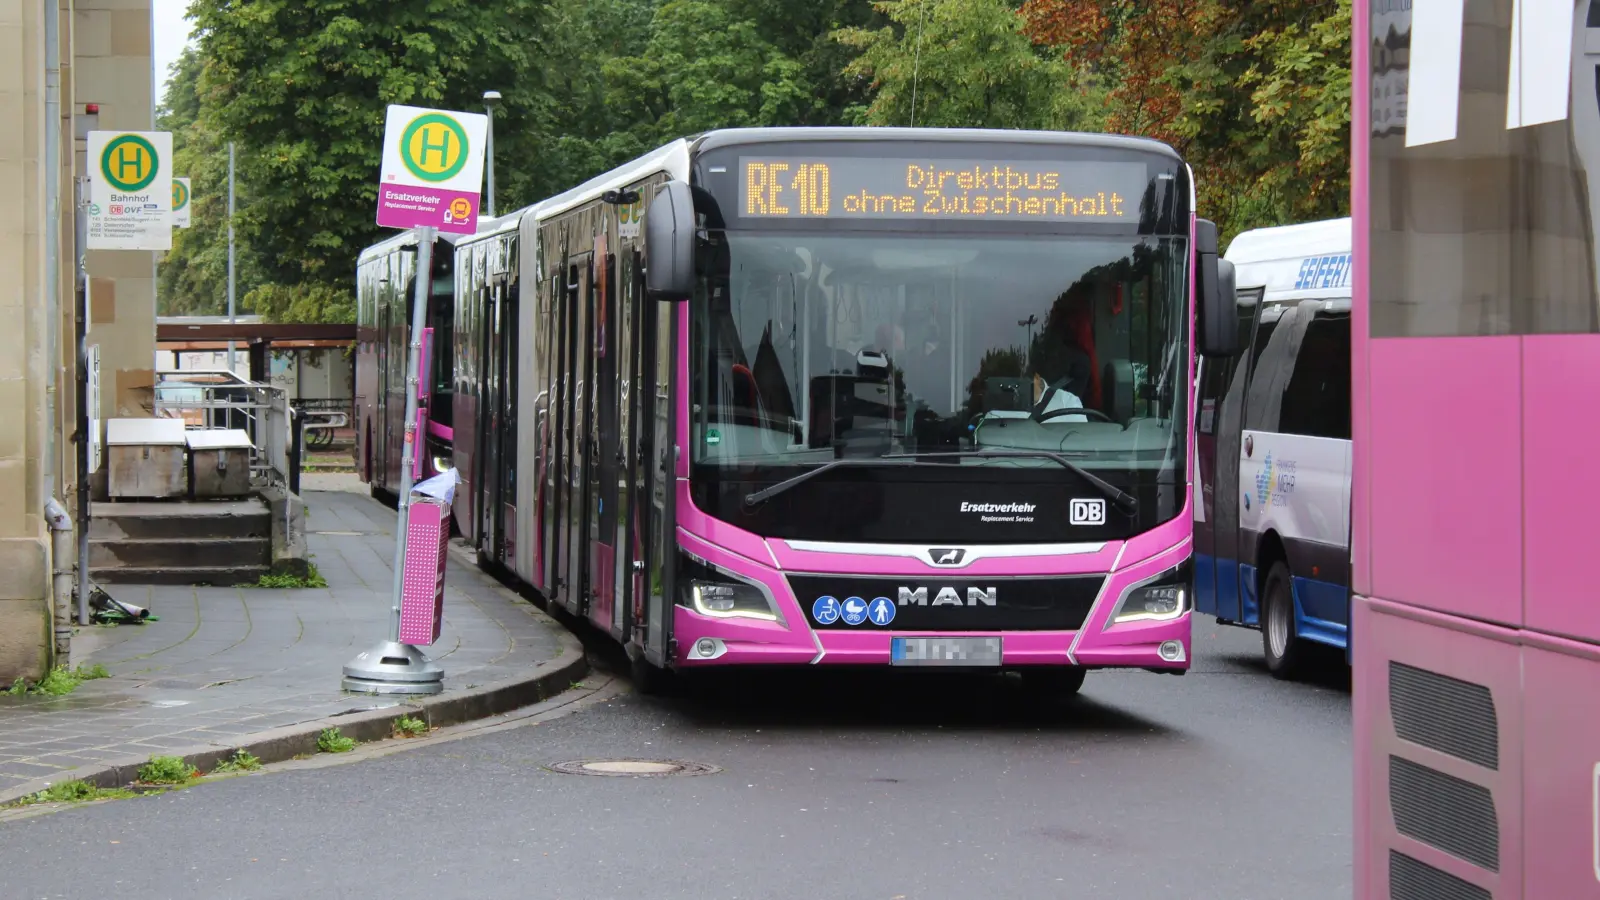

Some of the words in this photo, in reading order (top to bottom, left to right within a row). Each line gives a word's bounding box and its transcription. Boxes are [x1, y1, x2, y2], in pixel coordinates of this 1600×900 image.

[418, 128, 450, 167] H
[118, 147, 142, 179] H
[907, 164, 1059, 190] Direktbus
[110, 194, 149, 202] Bahnhof
[385, 190, 441, 204] Ersatzverkehr
[747, 162, 829, 215] RE10
[110, 205, 122, 214] DB
[124, 206, 142, 214] OVF
[384, 201, 417, 210] Replacement
[843, 189, 915, 213] ohne
[923, 189, 1123, 216] Zwischenhalt
[960, 502, 1036, 513] Ersatzverkehr
[1073, 501, 1103, 522] DB
[898, 587, 997, 606] MAN
